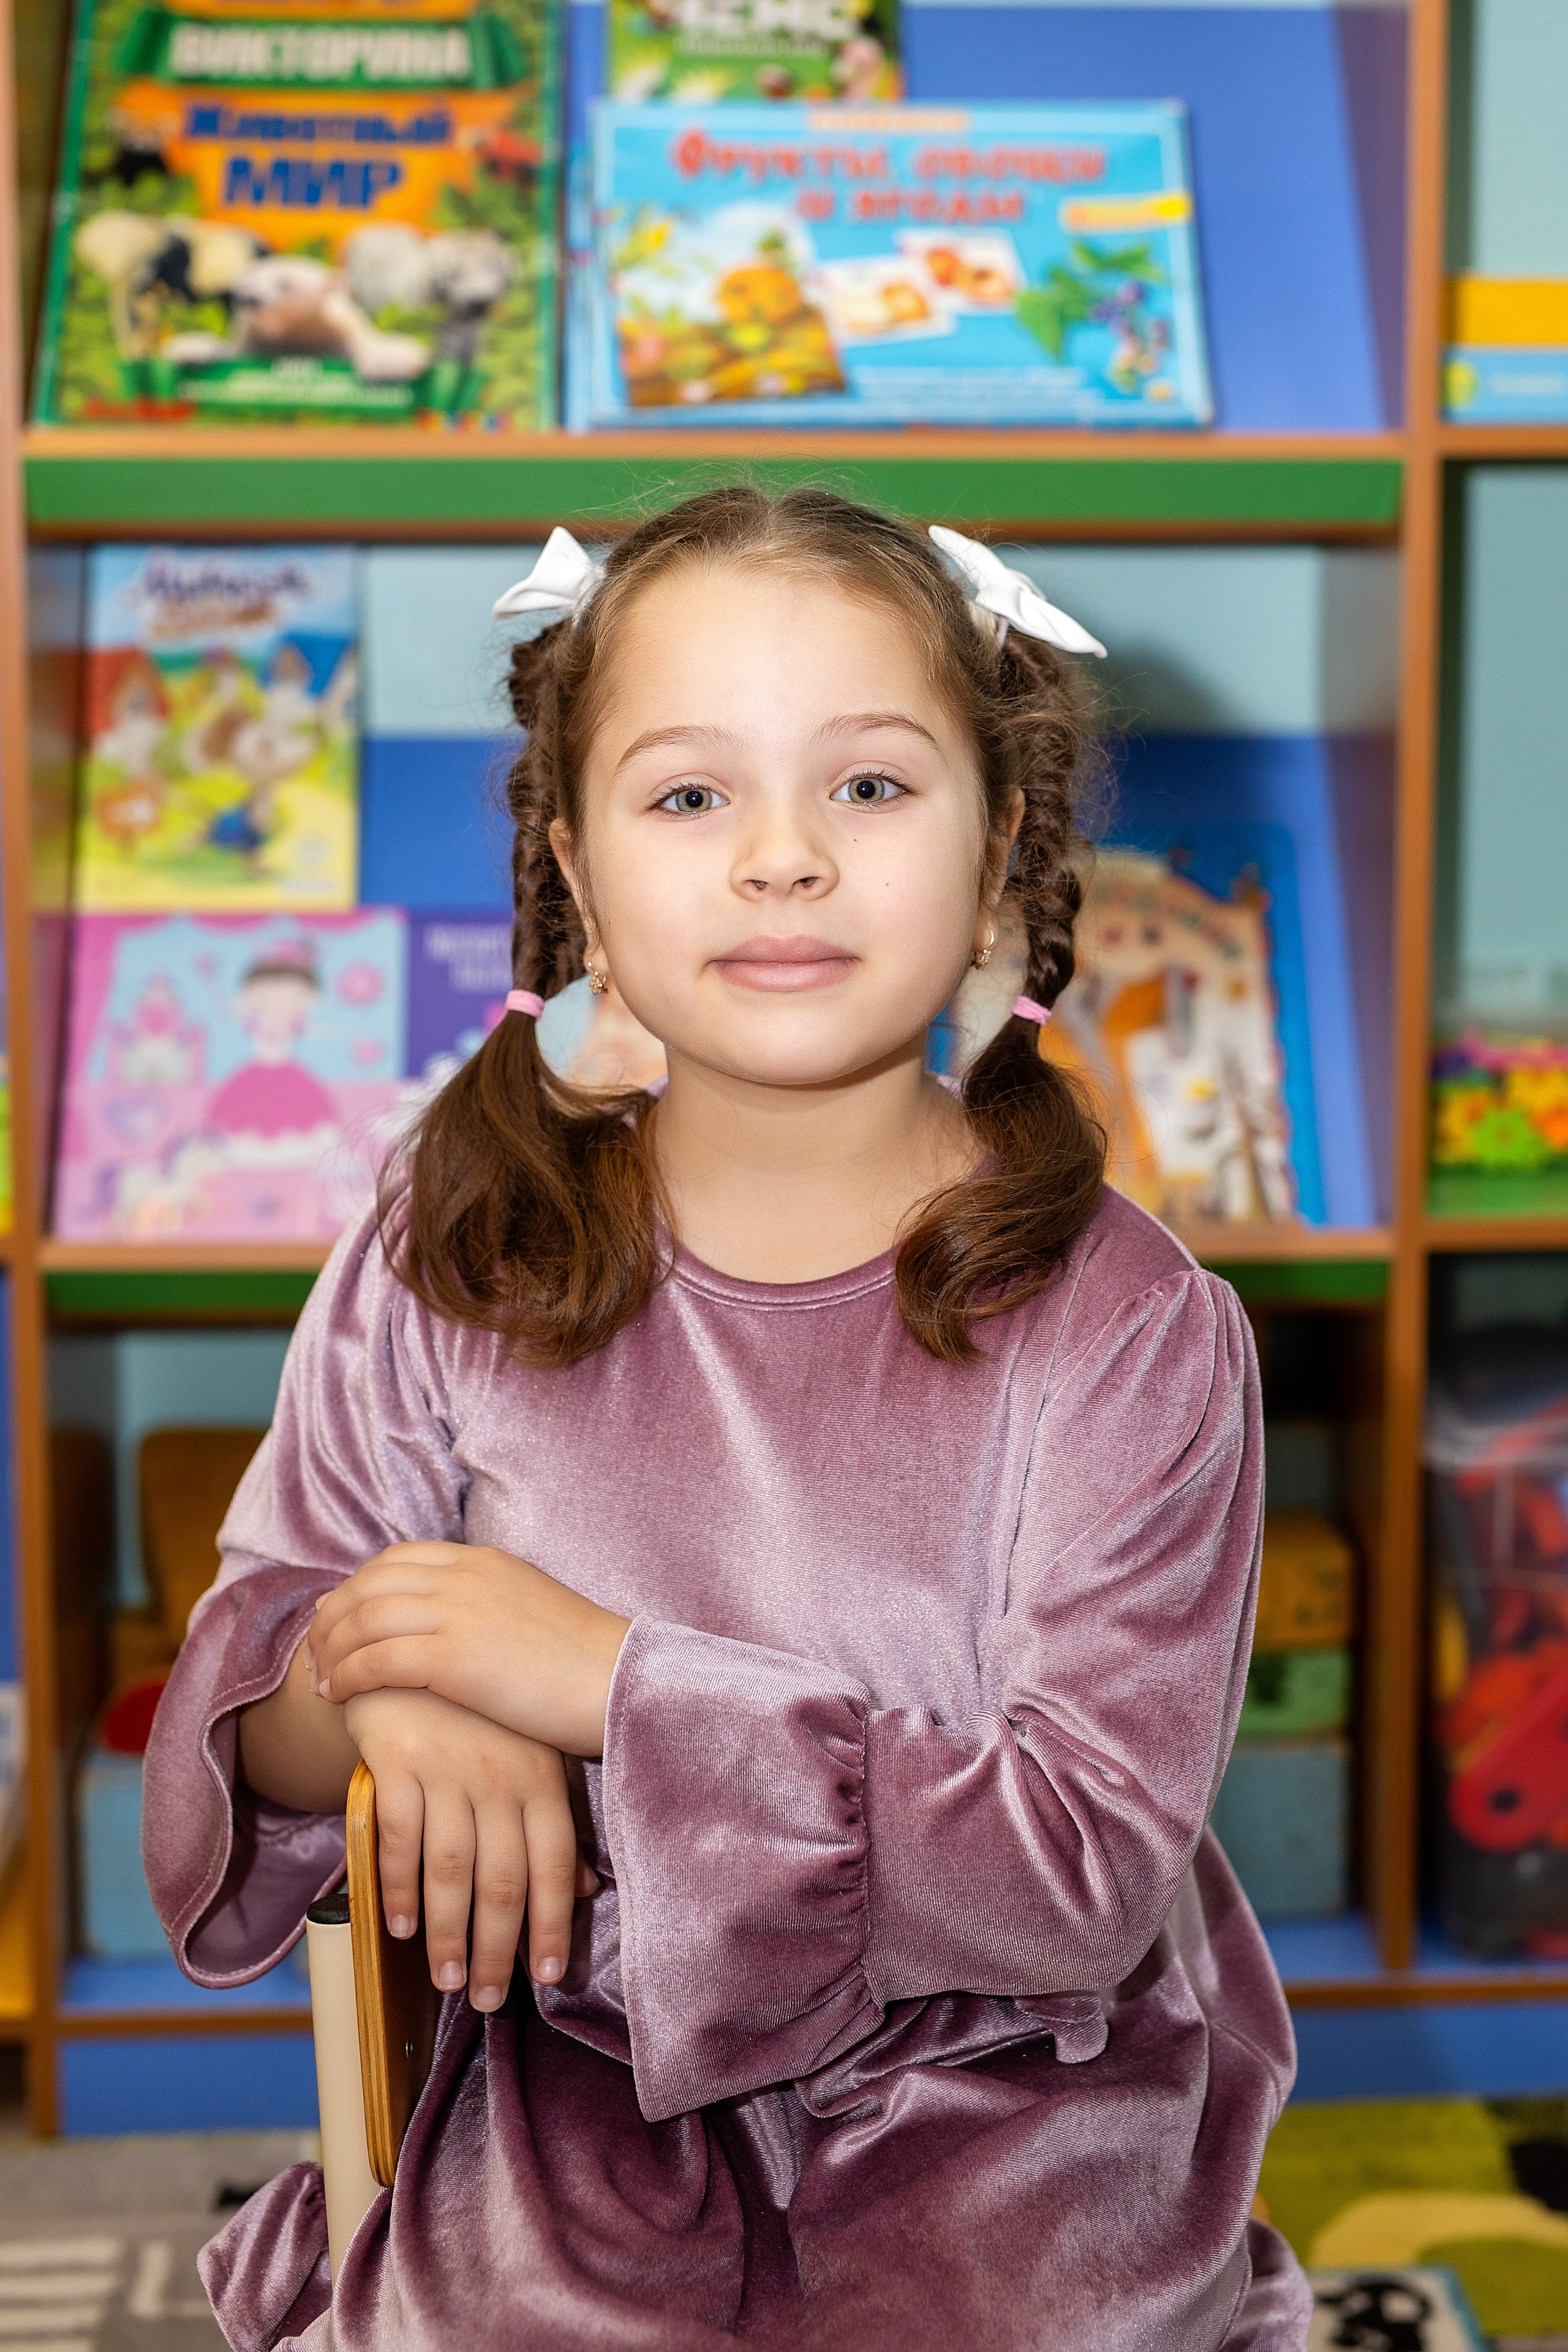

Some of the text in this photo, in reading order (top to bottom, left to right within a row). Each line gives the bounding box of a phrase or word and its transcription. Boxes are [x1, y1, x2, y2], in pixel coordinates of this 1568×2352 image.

[176, 23, 470, 81] ВИКТОРИНА
[189, 100, 448, 142] Животный
[223, 157, 402, 209] МИР
